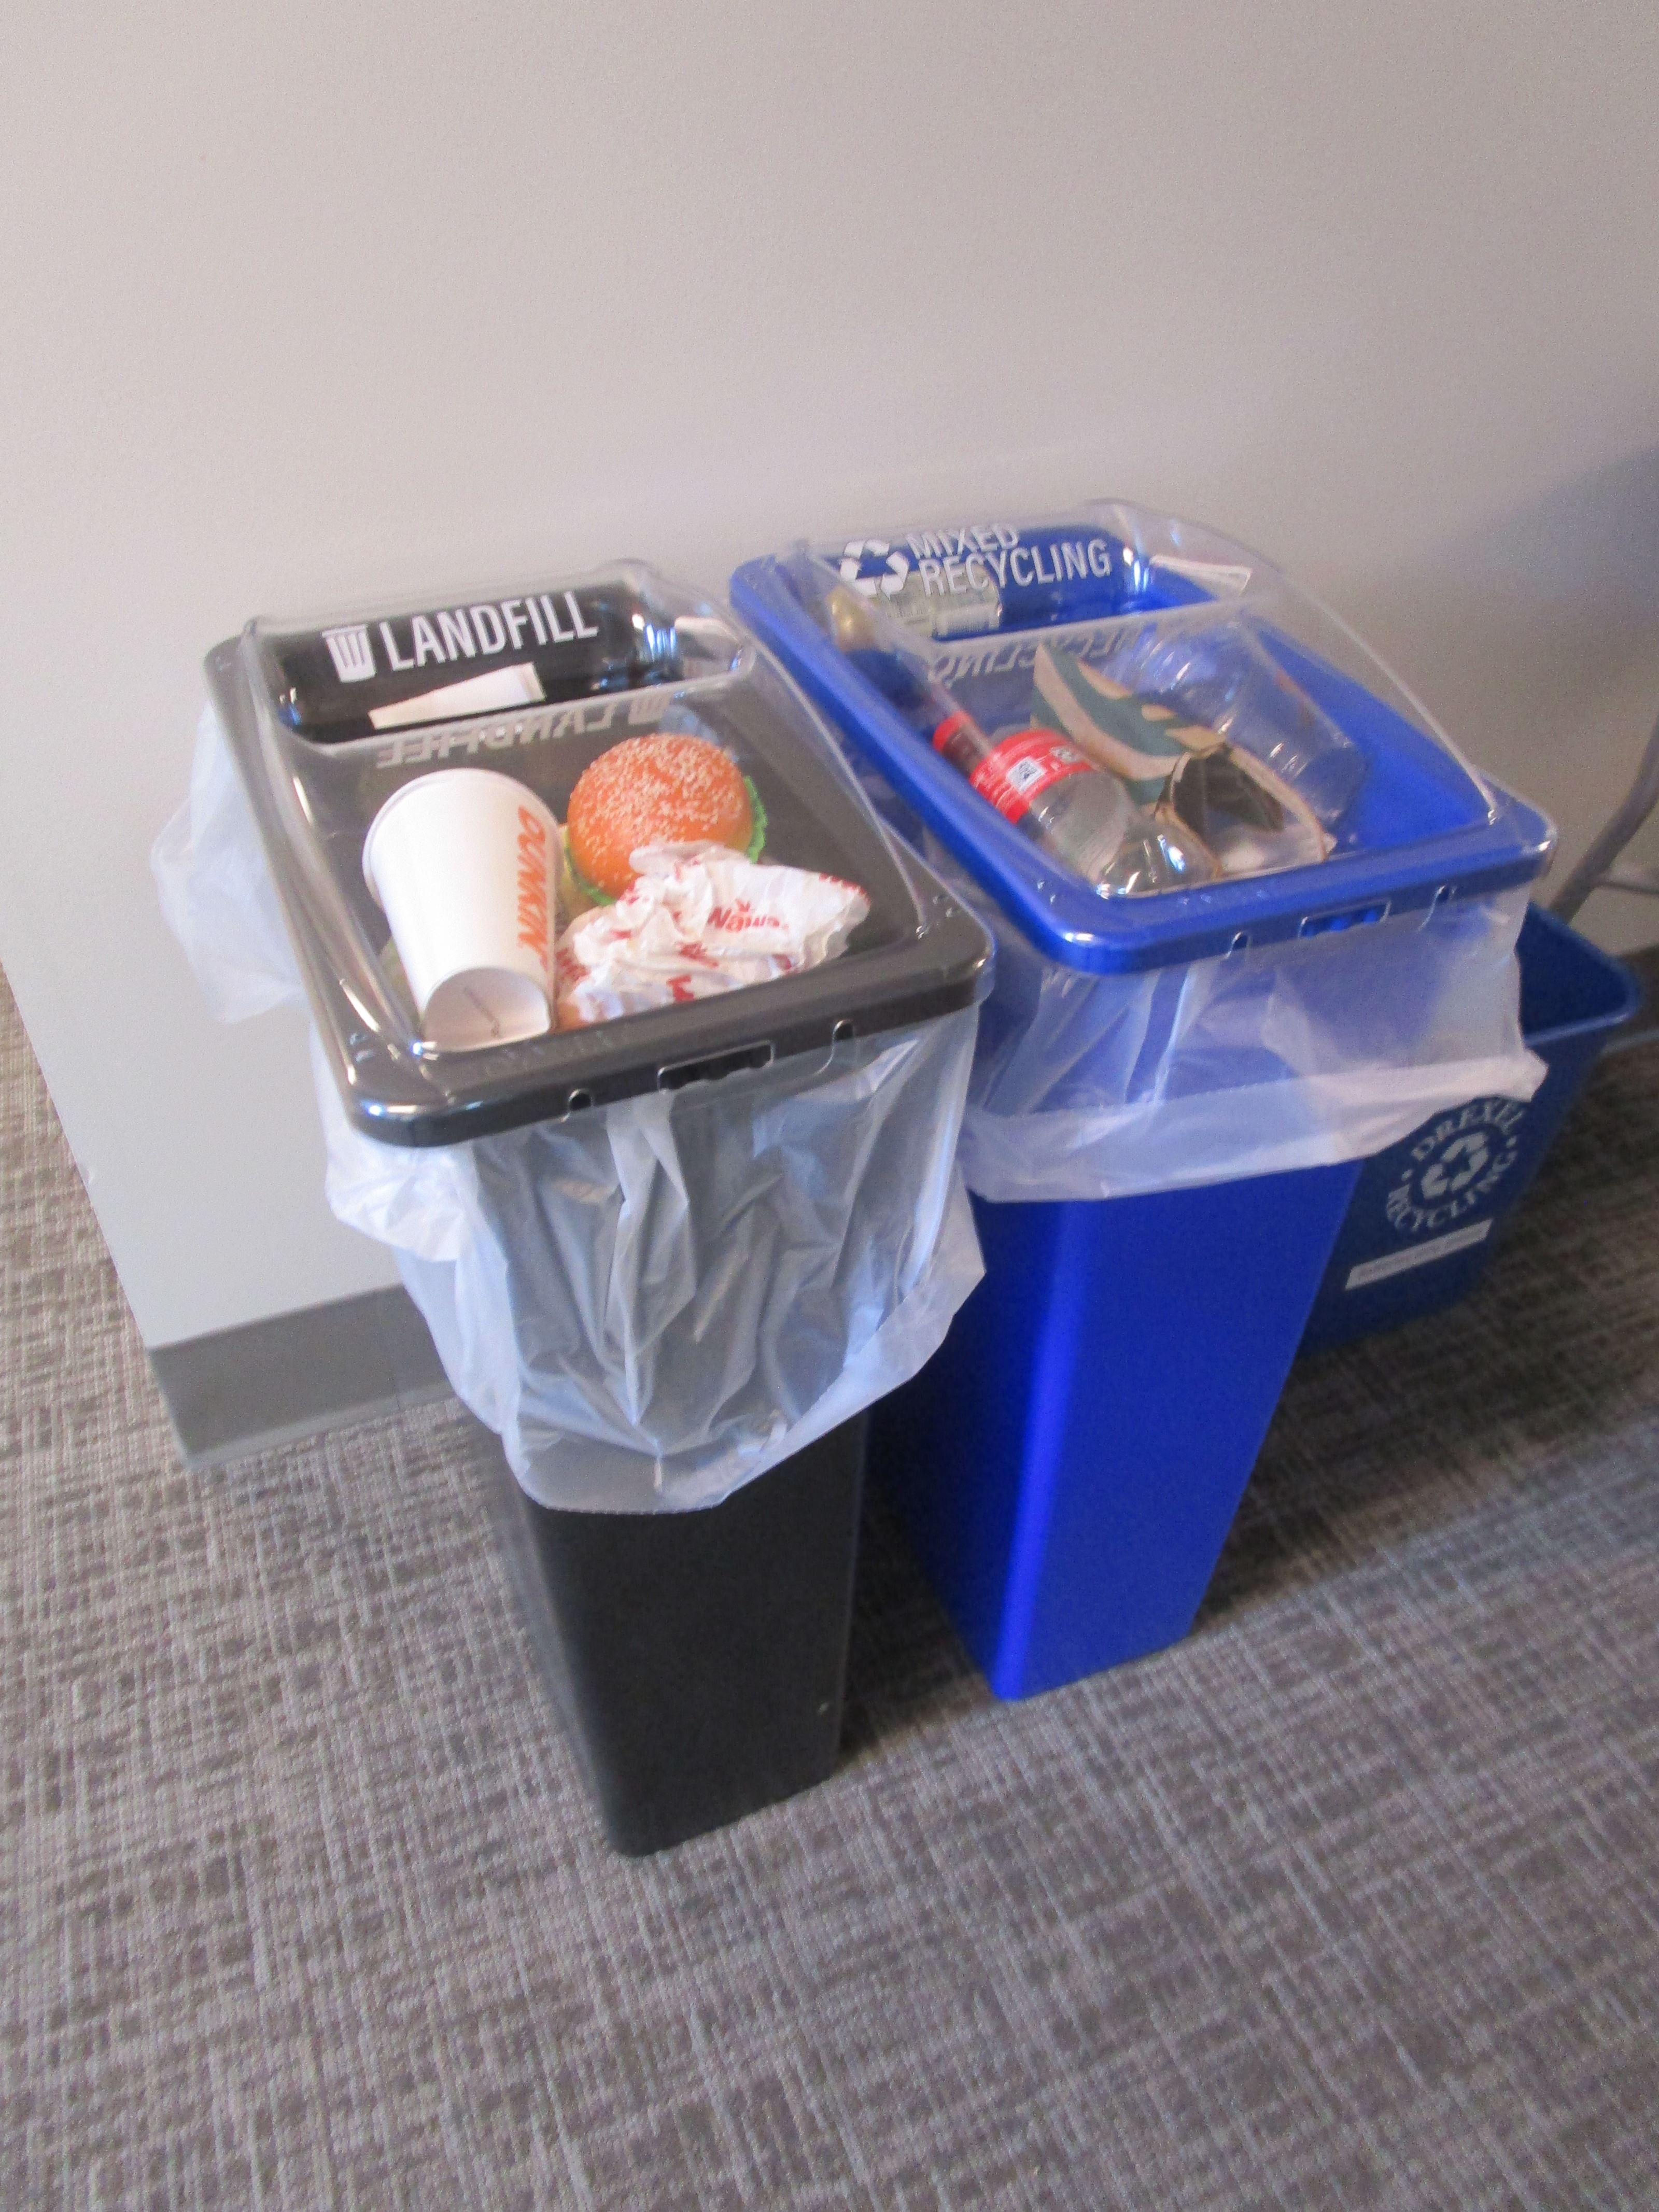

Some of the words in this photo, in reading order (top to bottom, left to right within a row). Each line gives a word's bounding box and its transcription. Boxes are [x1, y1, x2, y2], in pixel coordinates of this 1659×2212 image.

[908, 525, 1018, 559] MIXED
[919, 539, 1112, 596] RECYCLING
[379, 593, 598, 670] LANDFILL
